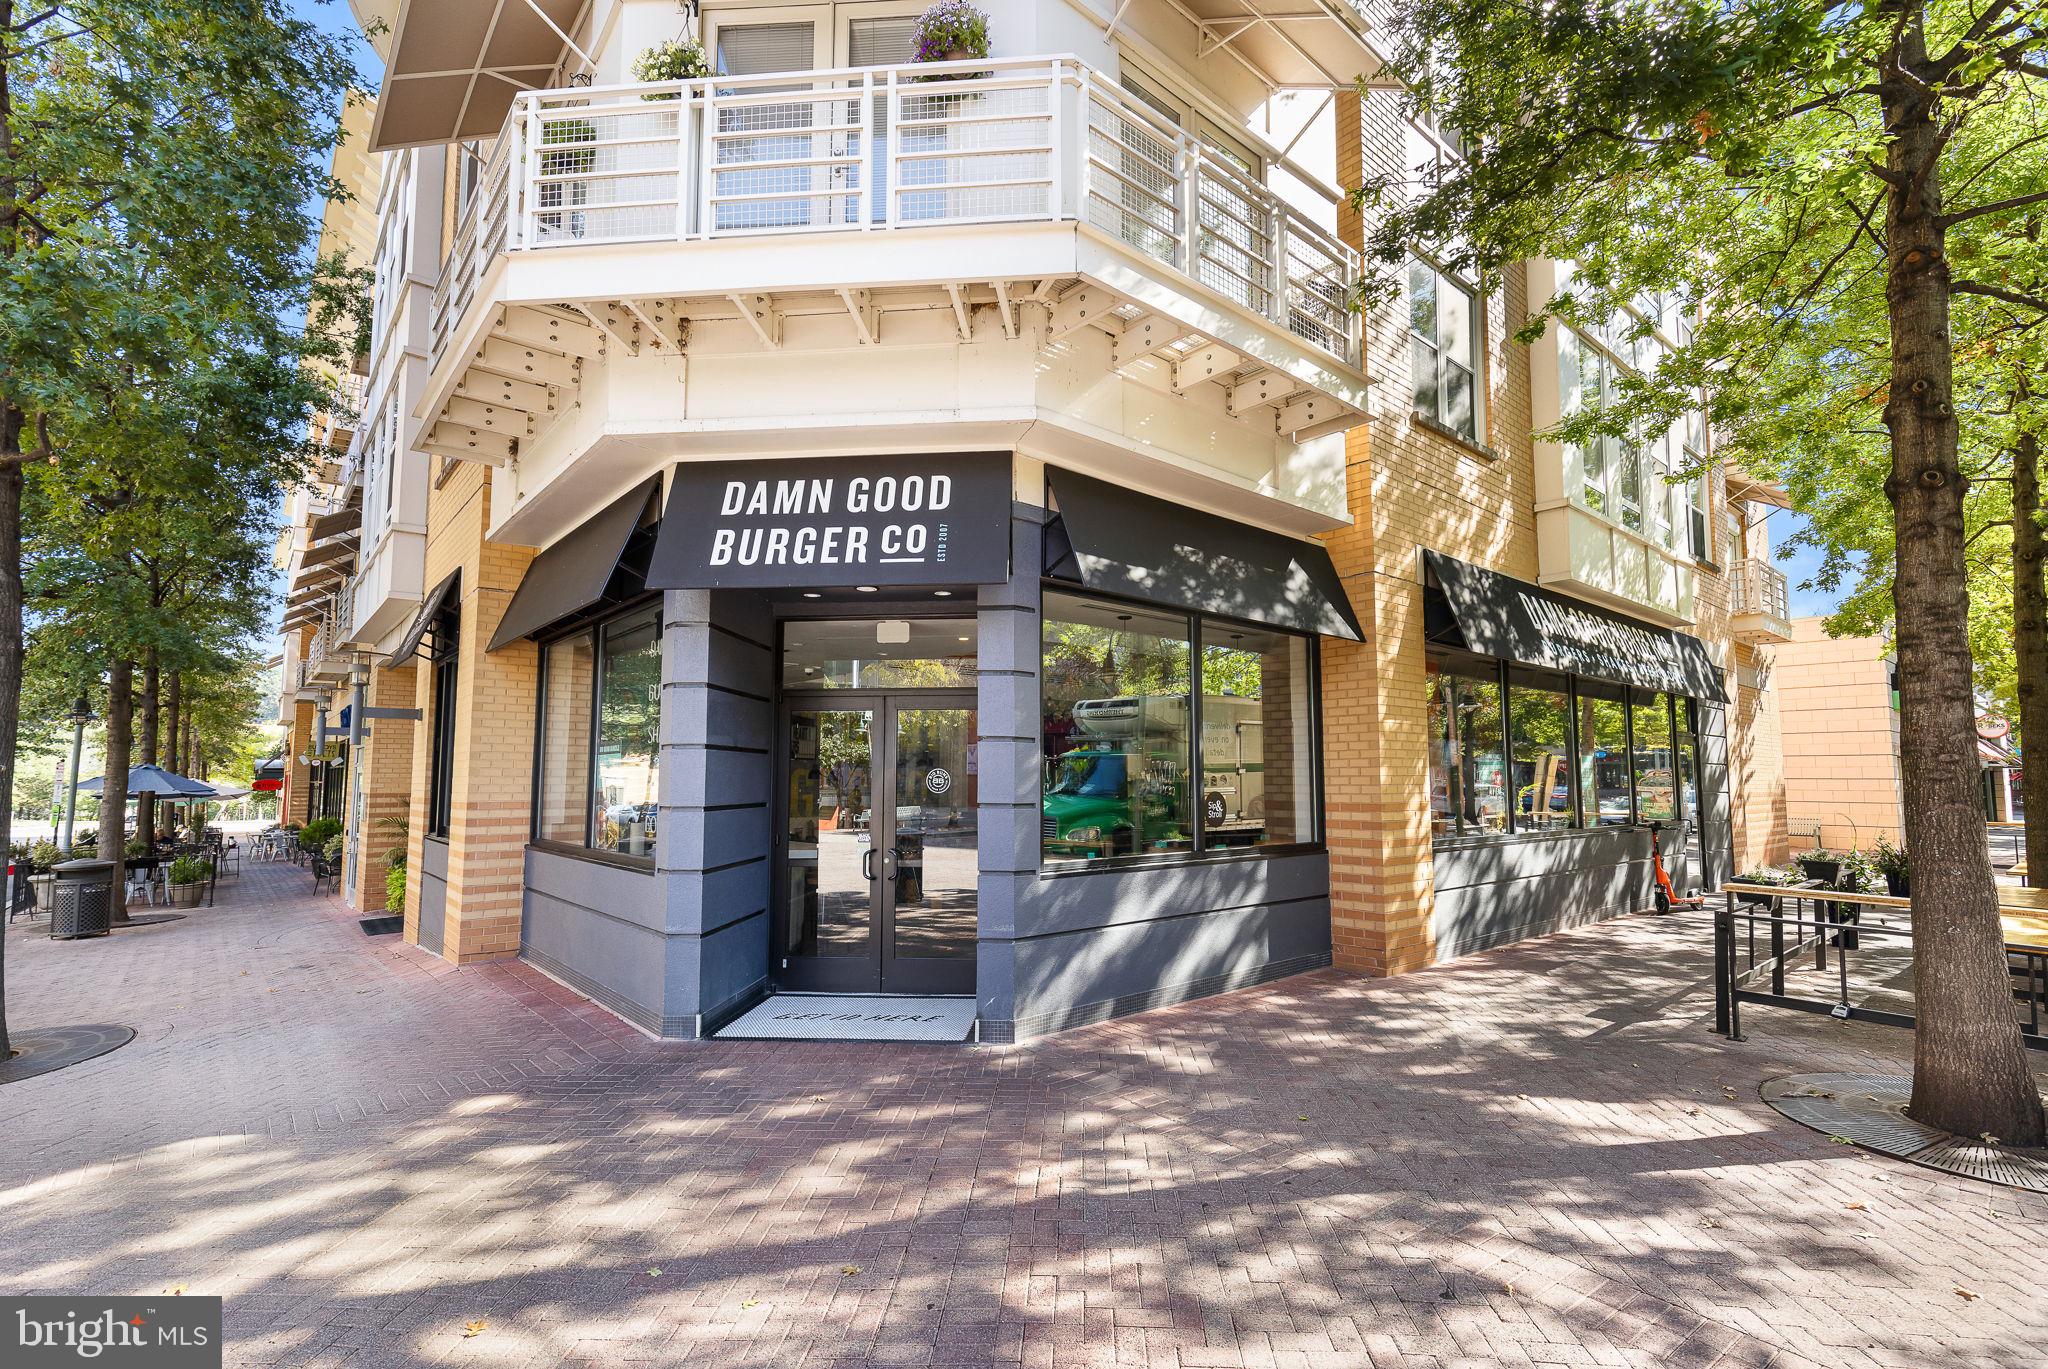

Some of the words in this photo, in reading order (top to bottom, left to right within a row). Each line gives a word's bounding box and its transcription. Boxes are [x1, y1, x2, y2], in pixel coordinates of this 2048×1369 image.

[720, 478, 834, 516] DAMN
[846, 475, 951, 513] GOOD
[709, 526, 869, 566] BURGER
[881, 524, 927, 554] CO
[938, 523, 949, 541] 2007
[936, 543, 947, 562] ESTD
[1518, 592, 1573, 639] DAMN
[863, 1014, 945, 1022] HERE
